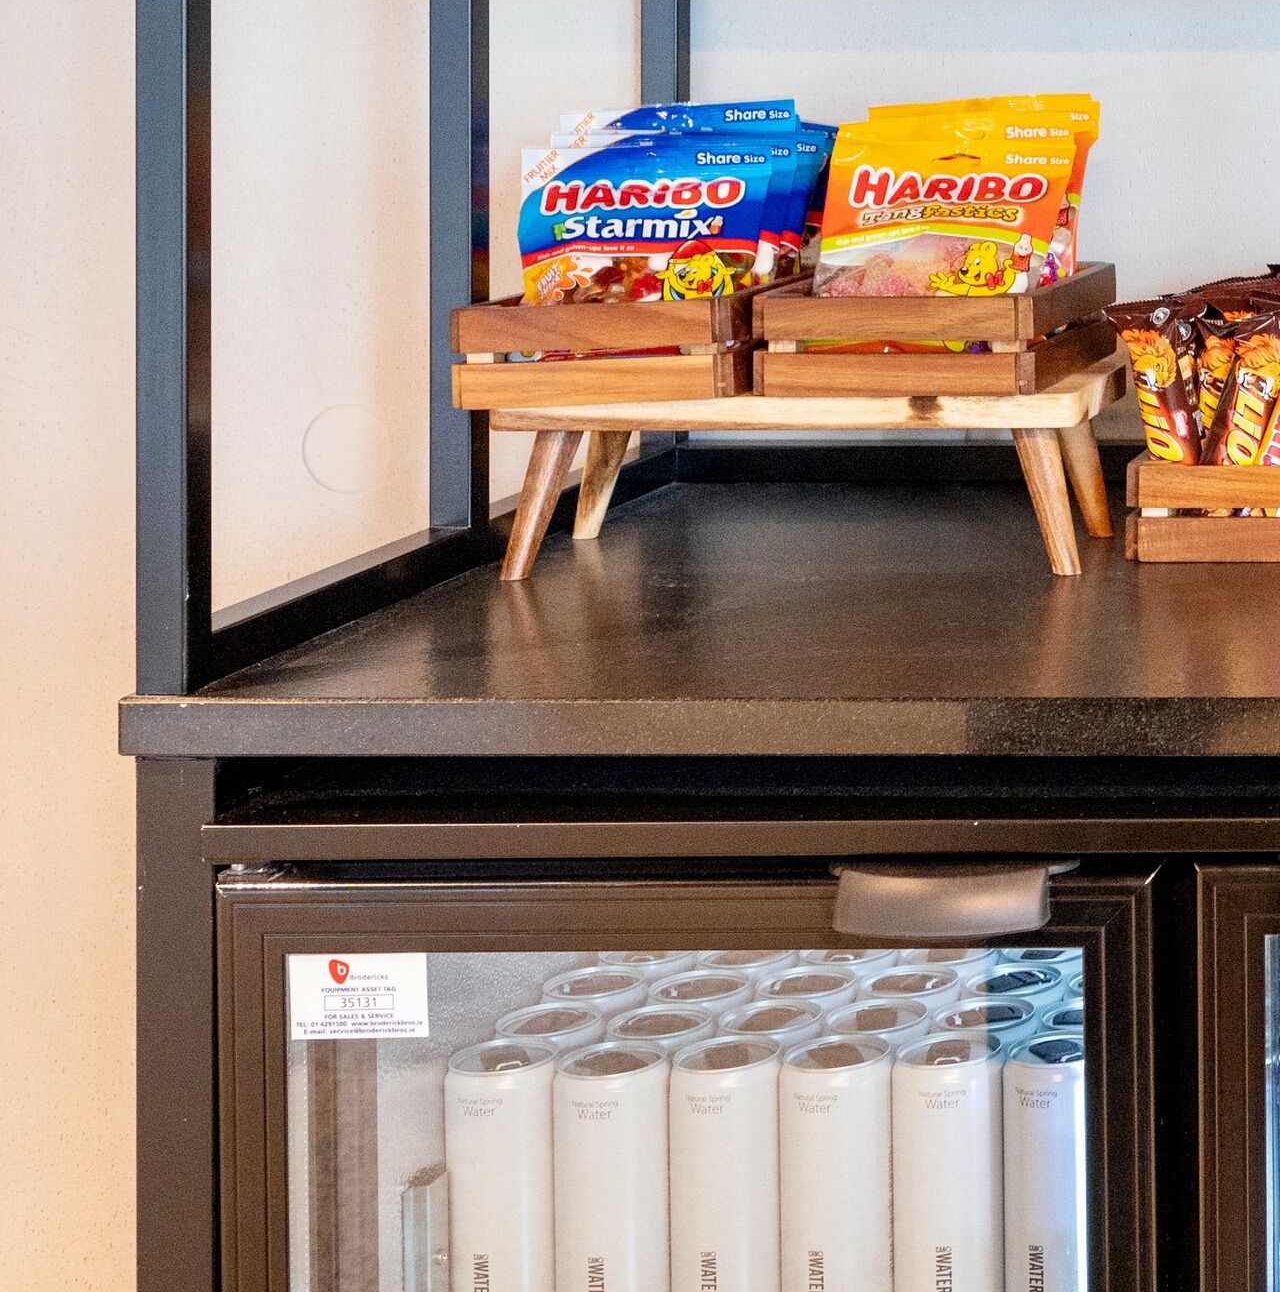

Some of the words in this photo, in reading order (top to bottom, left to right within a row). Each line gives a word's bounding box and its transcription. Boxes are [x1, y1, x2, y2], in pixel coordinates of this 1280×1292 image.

[725, 109, 767, 123] Share
[768, 110, 790, 120] Size
[1005, 126, 1047, 139] Share
[1050, 128, 1070, 137] Size
[797, 142, 817, 153] Size
[697, 153, 741, 166] Share
[744, 154, 765, 165] Size
[1005, 153, 1047, 166] Share
[1050, 157, 1070, 165] Size
[853, 169, 1045, 206] HARIBO
[544, 179, 743, 213] HARIBO
[562, 213, 712, 240] Starmix
[341, 997, 377, 1008] 35131
[925, 1098, 960, 1110] Water
[463, 1106, 496, 1118] Water
[577, 1109, 612, 1120] Water
